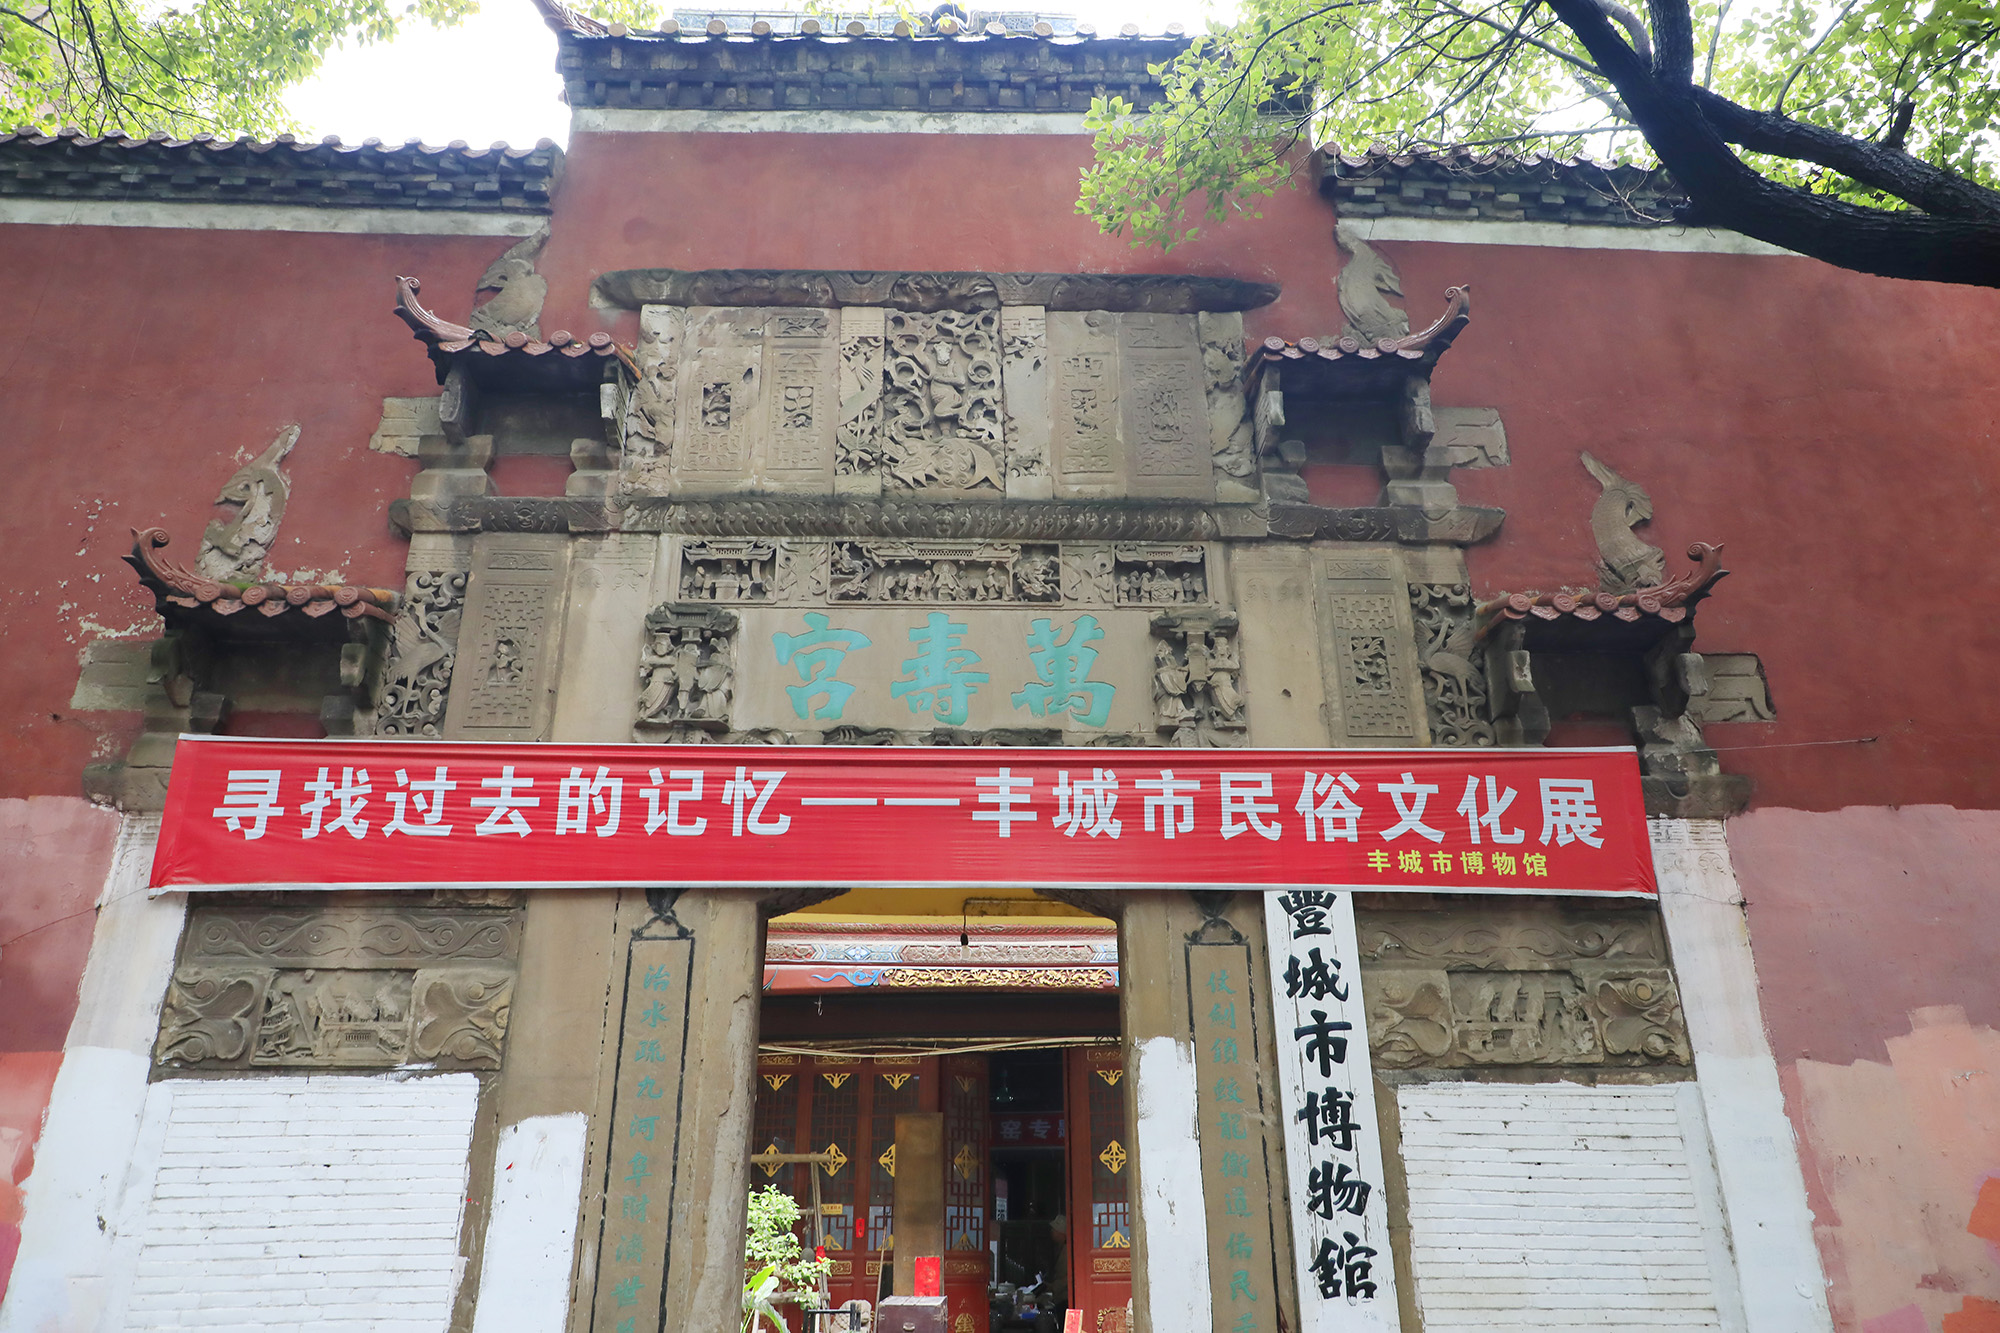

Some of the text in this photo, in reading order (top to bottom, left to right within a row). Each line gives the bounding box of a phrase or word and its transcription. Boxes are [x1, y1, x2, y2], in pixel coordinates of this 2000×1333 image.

[212, 765, 1605, 849] 寻找过去的记忆——丰城市民俗文化展
[1366, 849, 1549, 878] 丰城市博物馆
